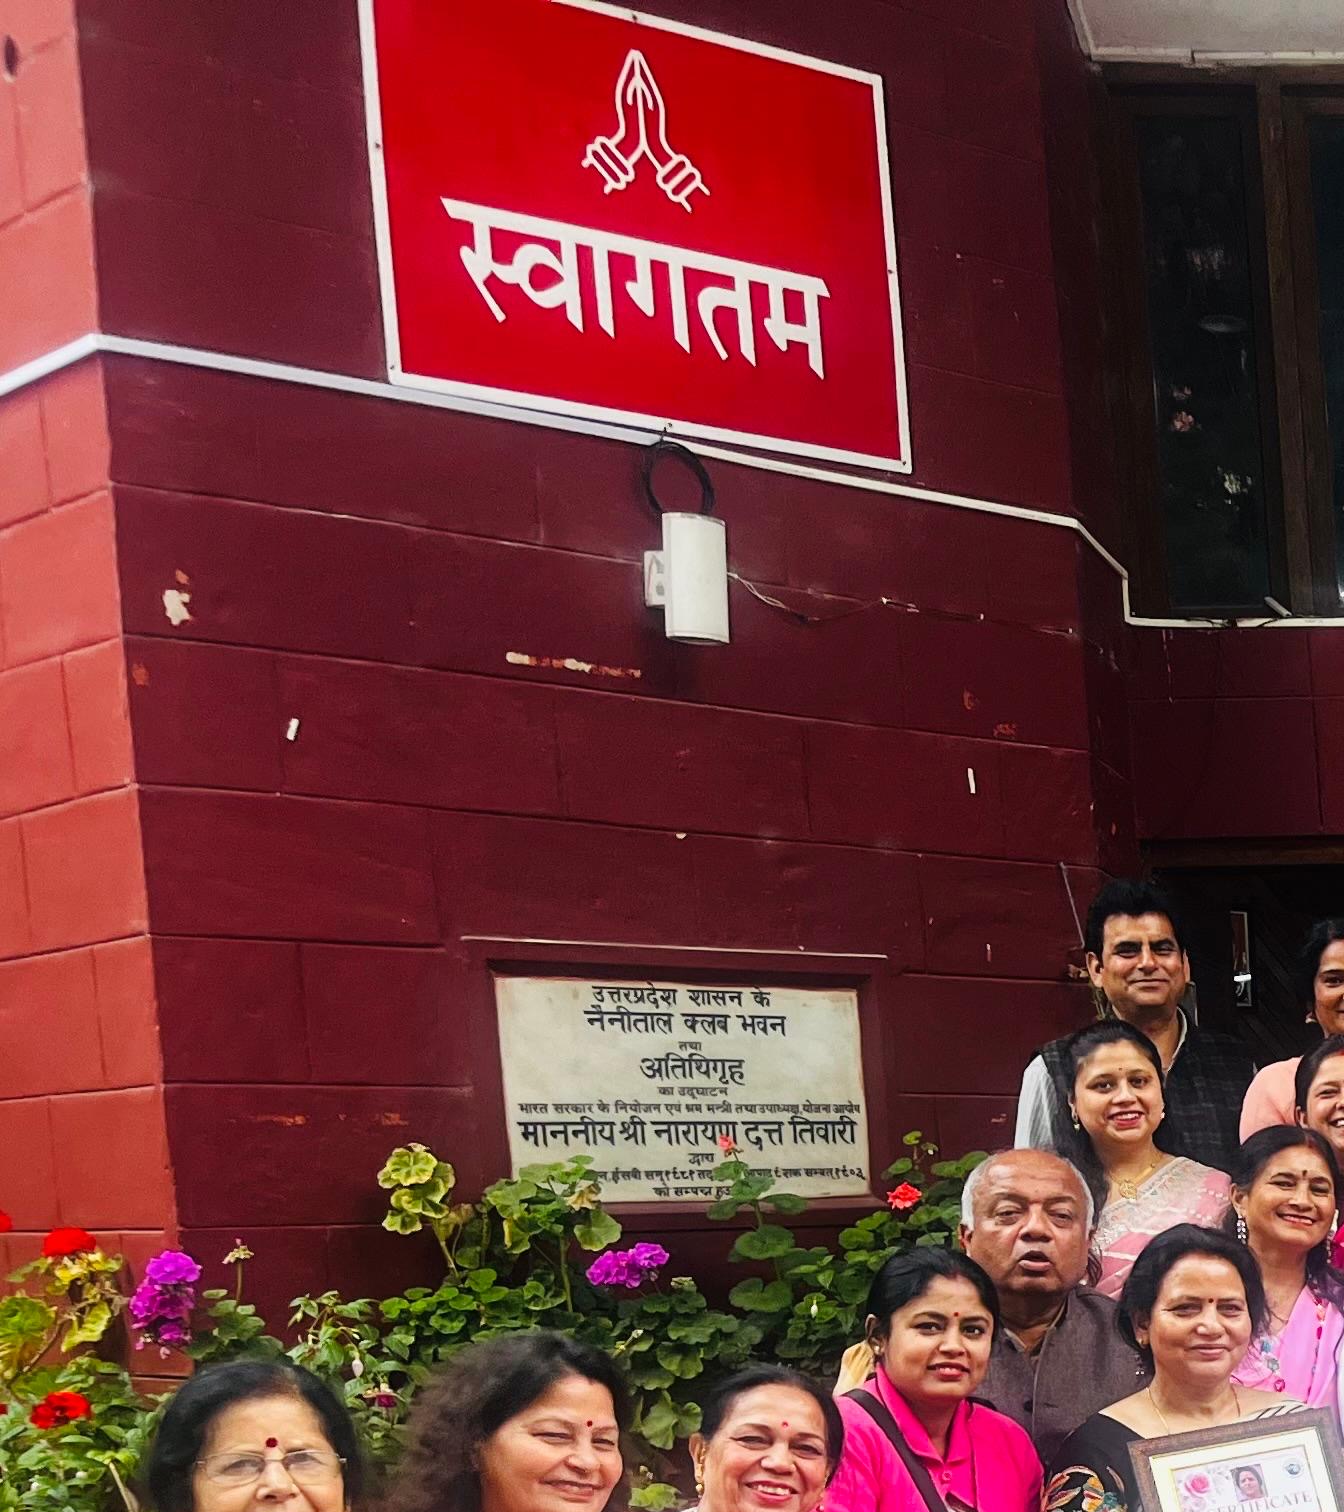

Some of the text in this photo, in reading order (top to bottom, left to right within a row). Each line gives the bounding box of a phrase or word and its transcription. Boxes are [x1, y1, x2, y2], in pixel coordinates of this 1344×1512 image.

[440, 197, 831, 380] स्वागतम
[687, 989, 743, 1008] शासन
[750, 986, 771, 1007] के
[583, 1004, 786, 1037] नैनीताल क्लब भवन
[678, 1041, 702, 1051] तथा
[640, 1052, 745, 1086] अतिथिगृह
[657, 1087, 674, 1096] का
[518, 1103, 548, 1114] भारत
[552, 1103, 594, 1114] सरकार
[596, 1099, 610, 1114] के
[517, 1115, 857, 1151] माननीय श्री नारायण दत्त तिवारी
